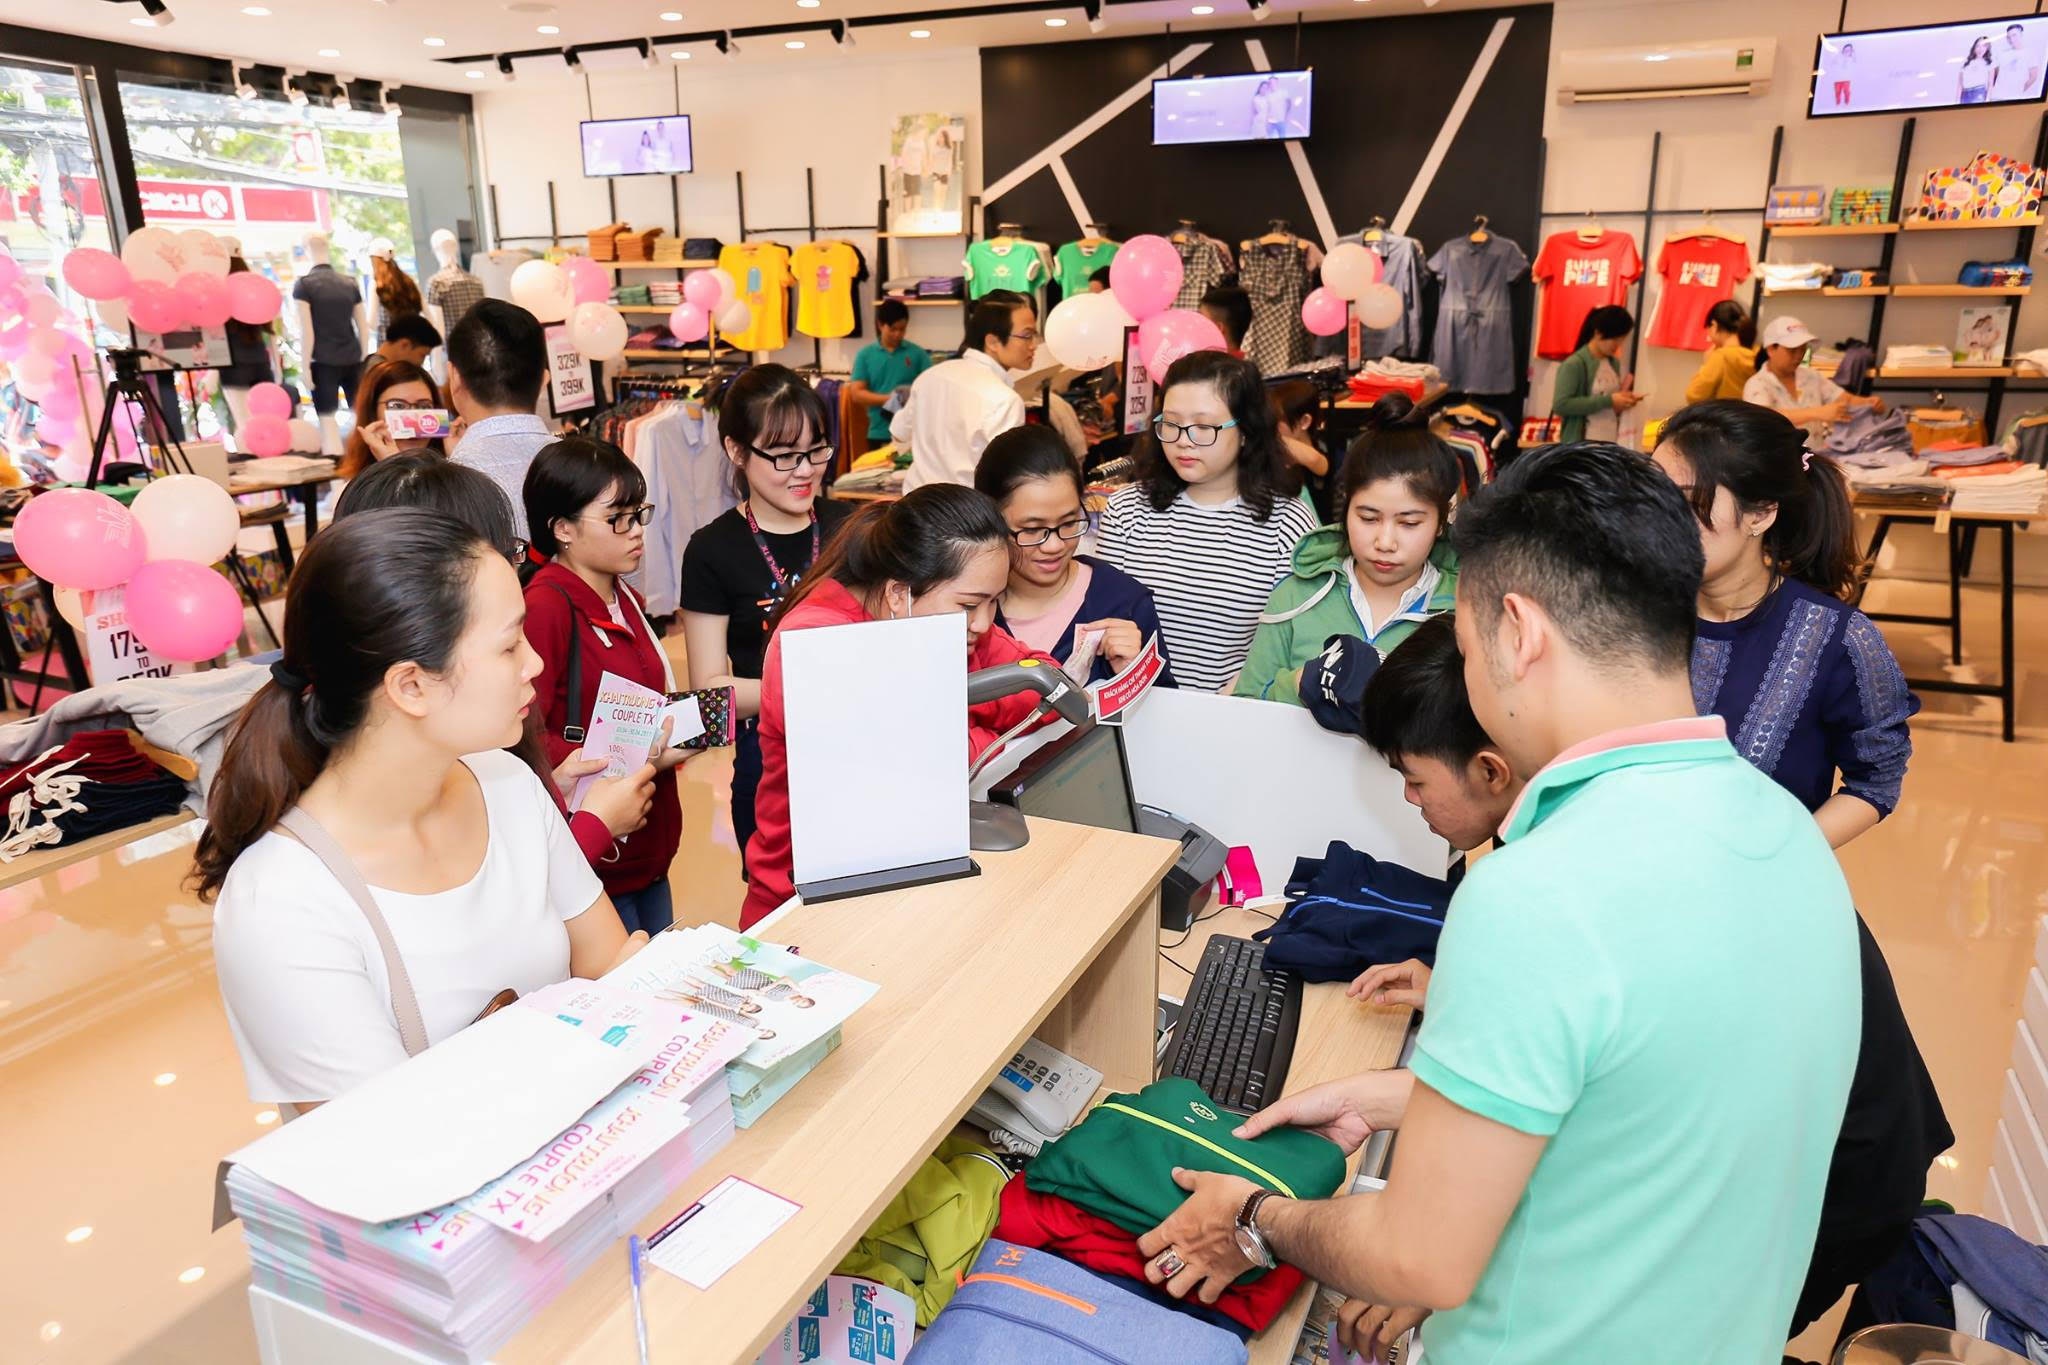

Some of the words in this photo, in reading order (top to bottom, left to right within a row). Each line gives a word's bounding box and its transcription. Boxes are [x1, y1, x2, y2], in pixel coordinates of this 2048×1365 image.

[557, 352, 581, 371] 329K
[560, 378, 585, 397] 399K
[137, 655, 150, 669] TO
[612, 708, 642, 724] COUPLE
[643, 712, 657, 726] TX
[633, 1034, 690, 1087] COUPLE
[518, 1122, 593, 1187] COUPLE
[488, 1188, 526, 1215] TX
